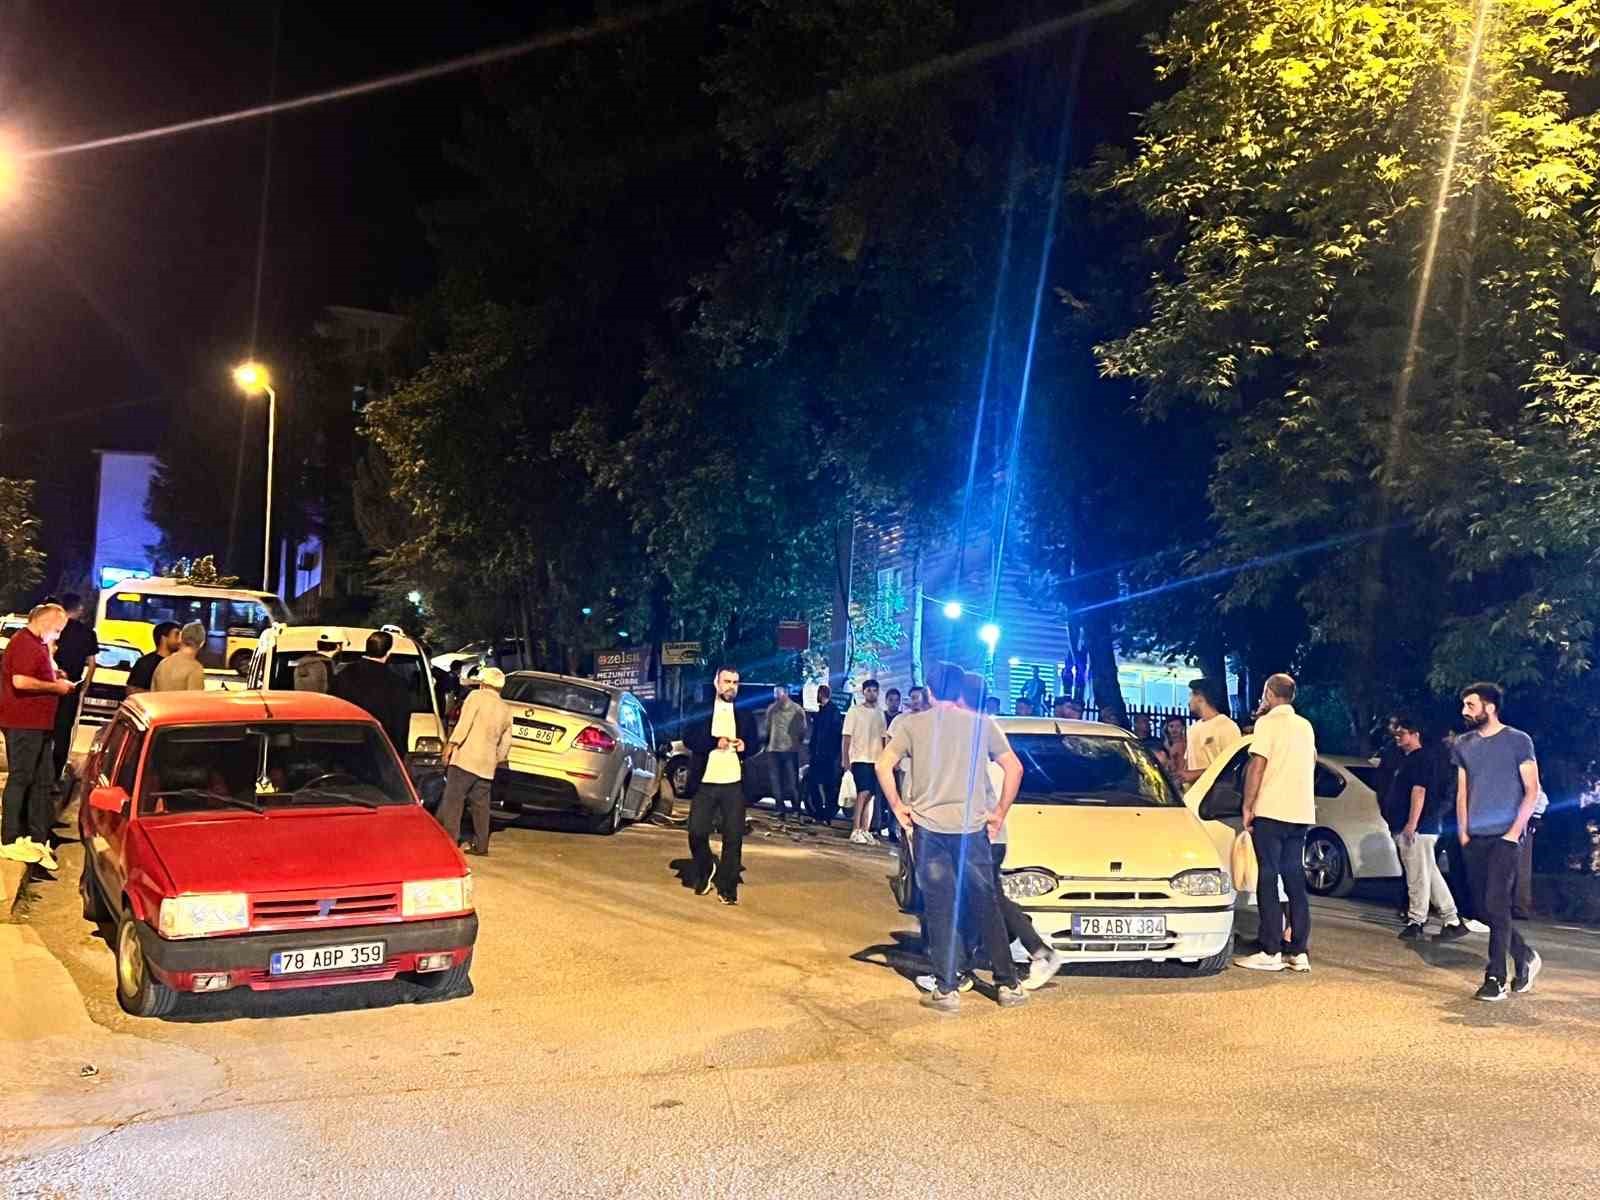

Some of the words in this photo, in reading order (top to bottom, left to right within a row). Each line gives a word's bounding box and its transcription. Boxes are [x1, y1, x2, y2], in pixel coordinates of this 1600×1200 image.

[518, 727, 529, 736] SG
[1082, 918, 1101, 934] 78
[1105, 918, 1133, 934] ABY
[1136, 918, 1164, 934] 384
[283, 953, 305, 970] 78
[312, 949, 344, 968] ABP
[351, 945, 381, 964] 359
